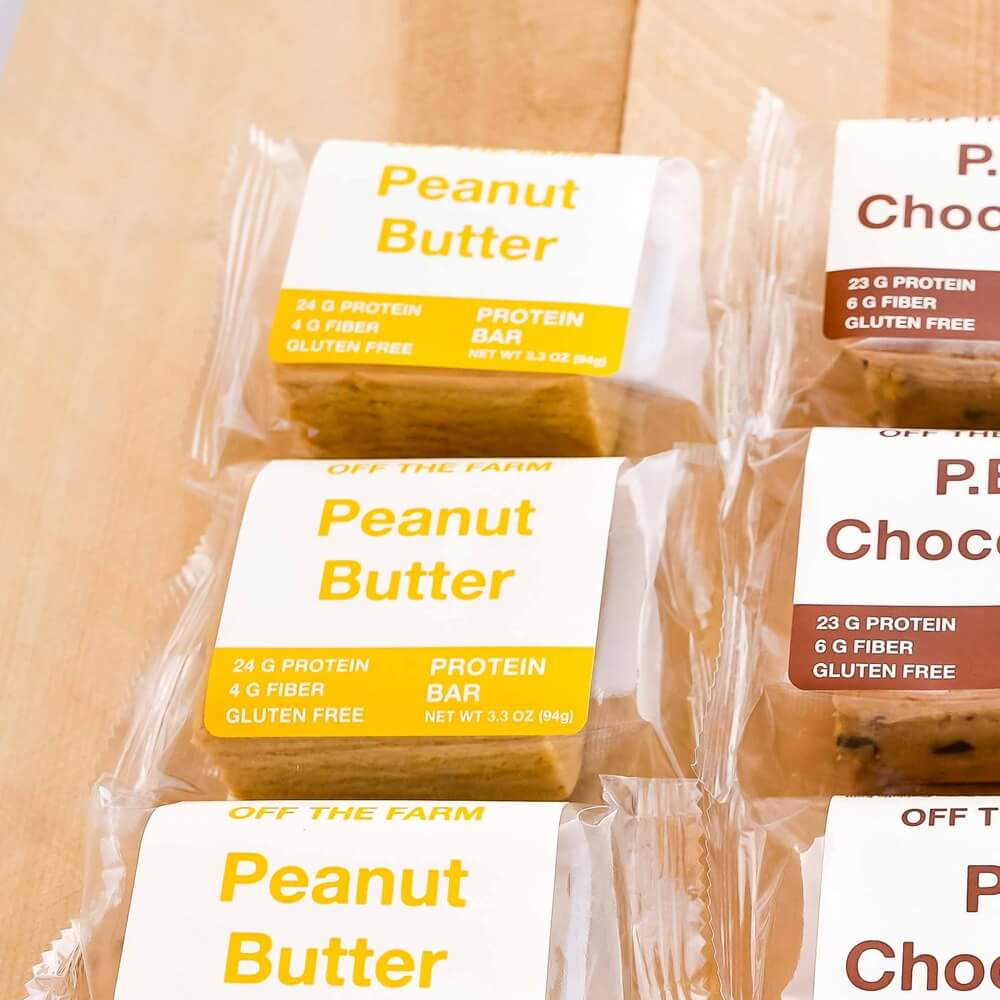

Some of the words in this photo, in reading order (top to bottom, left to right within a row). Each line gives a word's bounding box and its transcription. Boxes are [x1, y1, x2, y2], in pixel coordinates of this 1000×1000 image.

[377, 165, 580, 209] Peanut
[377, 217, 559, 262] Butter
[476, 306, 585, 328] PROTEIN
[844, 315, 922, 330] GLUTEN
[925, 316, 976, 332] FREE
[471, 327, 523, 345] BAR
[286, 338, 361, 353] GLUTEN
[364, 341, 414, 356] FREE
[326, 462, 385, 475] OFF
[399, 462, 458, 474] THE
[464, 461, 553, 473] FARM
[318, 498, 536, 537] Peanut
[319, 559, 516, 602] Butter
[430, 657, 547, 676] PROTEIN
[812, 662, 897, 678] GLUTEN
[902, 664, 956, 680] FREE
[229, 683, 241, 697] 4
[245, 682, 260, 697] G
[266, 681, 325, 697] FIBER
[426, 683, 481, 703] BAR
[225, 707, 307, 724] GLUTEN
[312, 706, 364, 723] FREE
[424, 710, 455, 723] NET
[459, 709, 483, 722] WT
[487, 709, 509, 722] 3.3
[512, 709, 535, 723] OZ
[538, 709, 574, 724] (94g)
[228, 806, 299, 820] OFF
[309, 806, 377, 821] THE
[386, 806, 485, 821] FARM
[901, 807, 969, 827] OFF
[219, 851, 469, 908] Peanut
[223, 931, 449, 989] Butter
